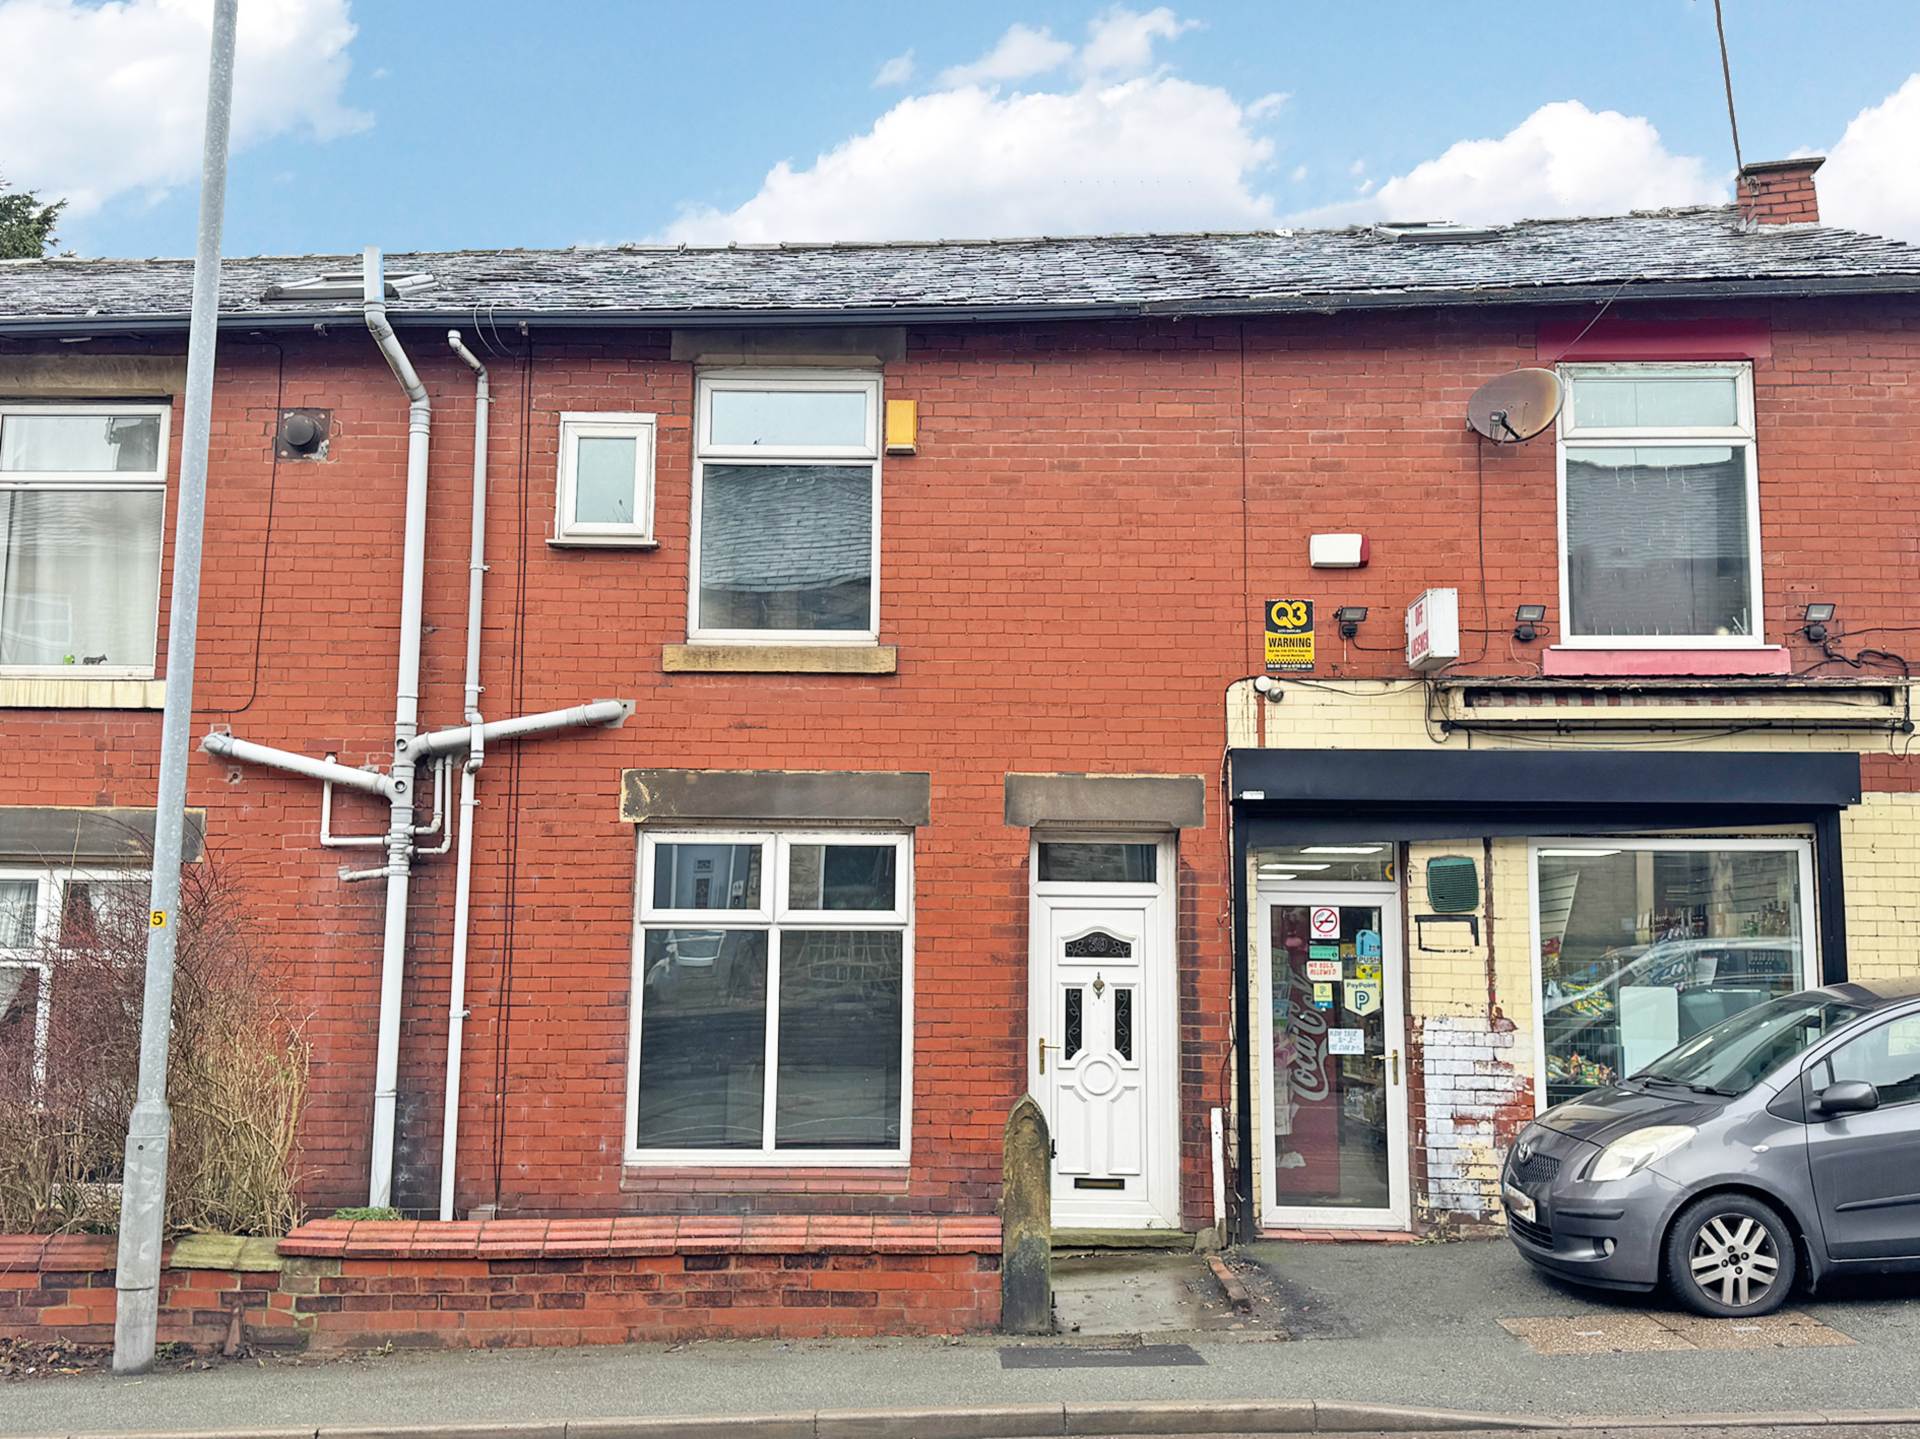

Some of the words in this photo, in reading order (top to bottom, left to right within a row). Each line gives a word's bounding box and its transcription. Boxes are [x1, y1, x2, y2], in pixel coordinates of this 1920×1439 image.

[1271, 601, 1308, 629] Q3
[1268, 637, 1312, 648] WARNING
[152, 911, 163, 926] 5
